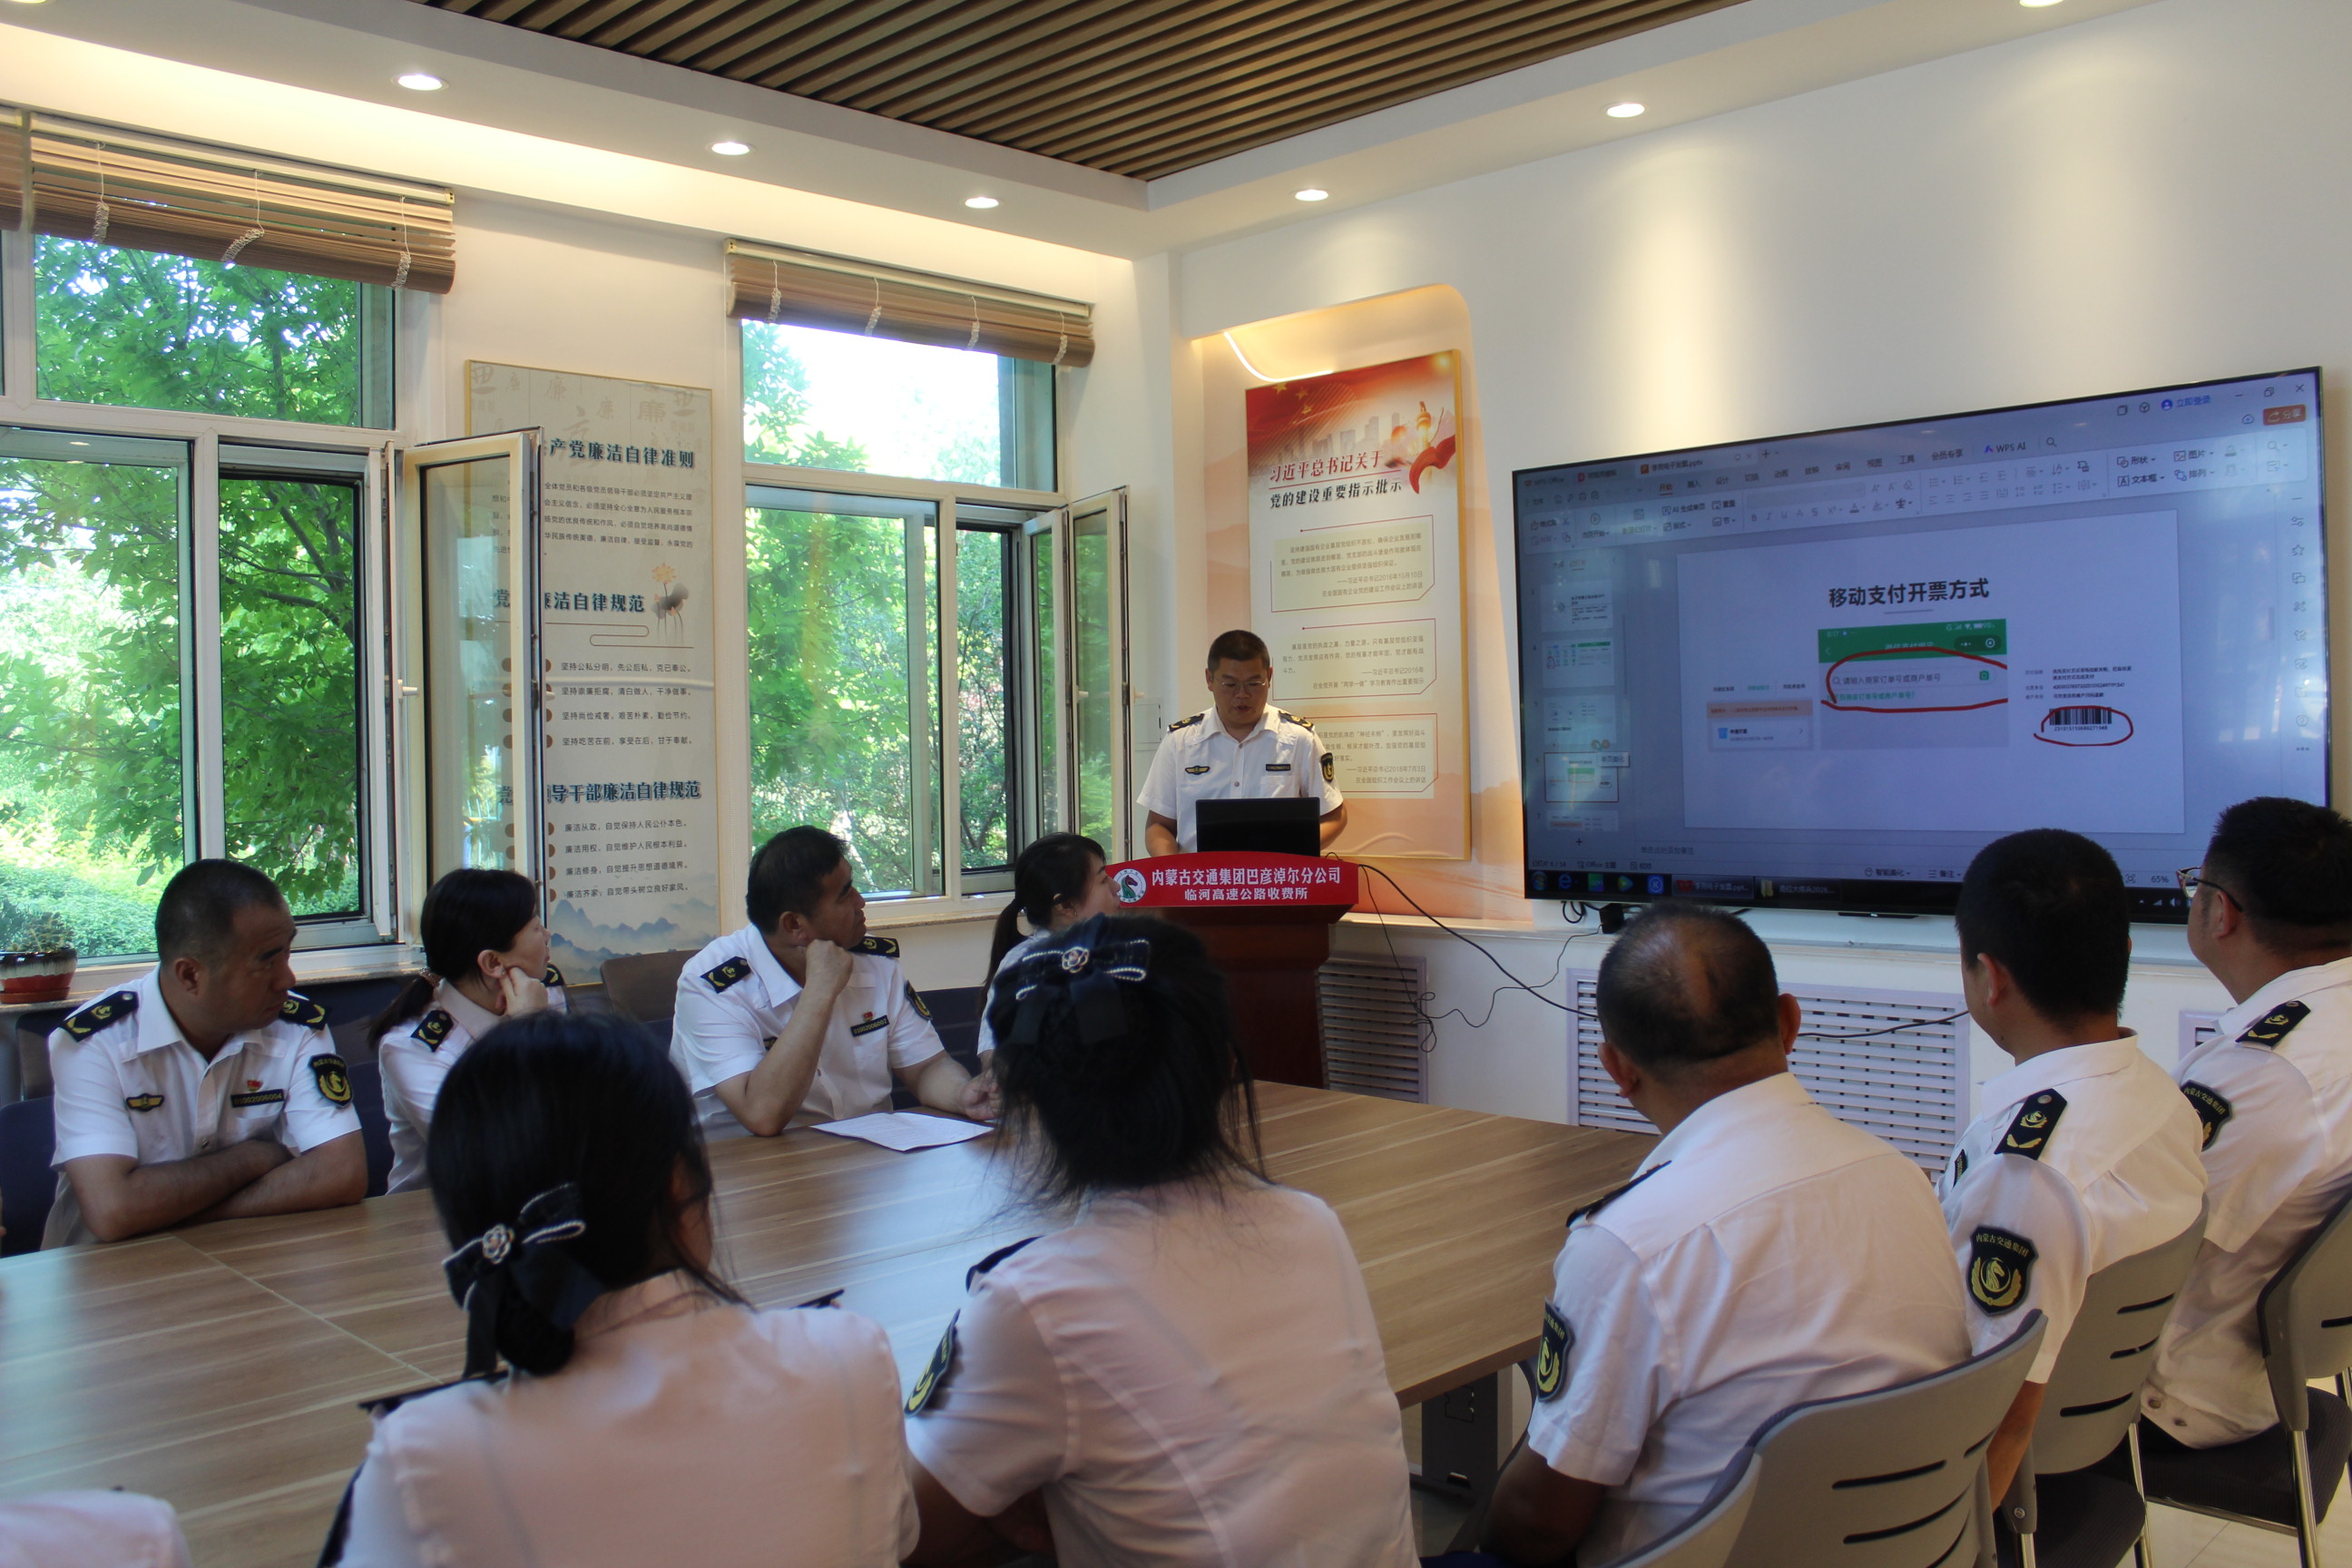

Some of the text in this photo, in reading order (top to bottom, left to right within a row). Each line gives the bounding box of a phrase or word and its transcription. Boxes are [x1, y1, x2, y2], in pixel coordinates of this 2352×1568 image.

[544, 437, 695, 469] 产党廉洁自律准则
[1996, 442, 2026, 453] WPS AI
[1269, 450, 1384, 483] 习近平总书记关于
[1899, 455, 1916, 465] 工具
[1269, 478, 1403, 510] 党的建设重要指示批示
[1828, 577, 1991, 608] 移动支付开票方式
[1151, 866, 1341, 887] 内蒙古交通集团巴彦淖尔分公司
[2151, 875, 2170, 884] 65%
[1184, 887, 1308, 901] 临河高速公路收费所
[1975, 1233, 2030, 1258] 内蒙古交通集团
